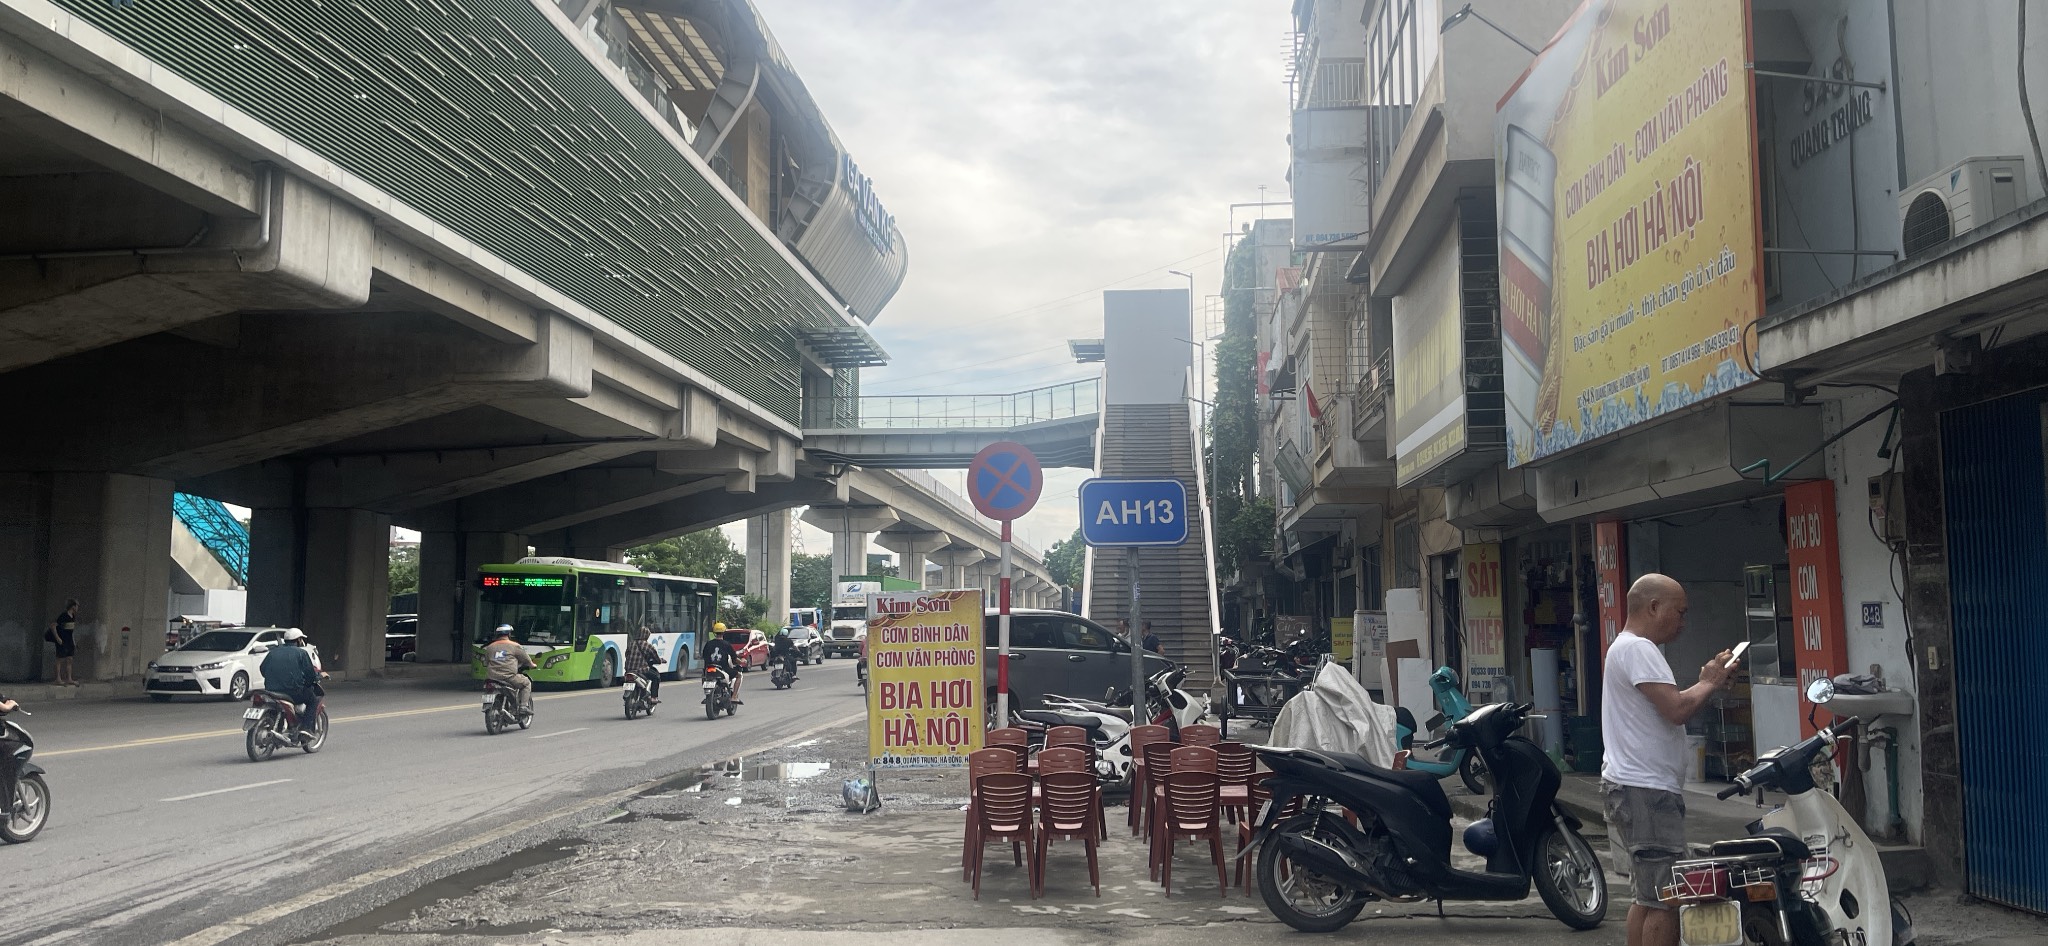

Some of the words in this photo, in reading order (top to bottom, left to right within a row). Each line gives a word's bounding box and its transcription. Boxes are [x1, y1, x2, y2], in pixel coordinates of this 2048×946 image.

[1596, 42, 1630, 100] Kim
[1633, 2, 1671, 64] Sơn
[1565, 178, 1584, 220] CƠM
[1584, 160, 1606, 205] BÌNH
[1606, 141, 1626, 187] DÂN
[1634, 116, 1658, 164] CƠM
[1660, 95, 1684, 145] VĂN
[1685, 57, 1729, 125] PHÒNG
[1791, 119, 1831, 169] QUANG
[1831, 90, 1873, 142] TRUNG
[1586, 228, 1612, 291] BIA
[1613, 205, 1641, 274] HƠI
[1643, 179, 1668, 255] HÀ
[1670, 155, 1704, 240] NỘI
[1573, 335, 1586, 354] Đặc
[1587, 325, 1599, 345] sản
[1616, 300, 1635, 330] muối
[1641, 293, 1656, 317] thịt
[1658, 282, 1679, 308] chân
[1680, 271, 1695, 302] giò
[1705, 258, 1714, 282] xì
[1717, 246, 1736, 276] dầu
[1728, 326, 1740, 344] 431
[1095, 499, 1175, 525] AH13
[1789, 503, 1807, 550] PHỞ
[1808, 504, 1821, 548] BÒ
[1467, 547, 1499, 598] SẮT
[1798, 562, 1819, 600] CƠM
[876, 597, 912, 614] Kim
[916, 596, 951, 614] Sơn
[1863, 606, 1881, 623] 848
[882, 626, 909, 644] CƠM
[912, 623, 941, 643] BÌNH
[944, 622, 969, 642] DÂN
[1468, 610, 1504, 656] THÉP
[1802, 610, 1822, 651] VĂN
[876, 650, 903, 668] CƠM
[906, 648, 931, 667] VĂN
[934, 646, 976, 667] PHÒNG
[880, 681, 923, 710] BIA
[930, 678, 973, 709] HƠI
[884, 713, 919, 747] HÀ
[926, 712, 970, 752] NỘI
